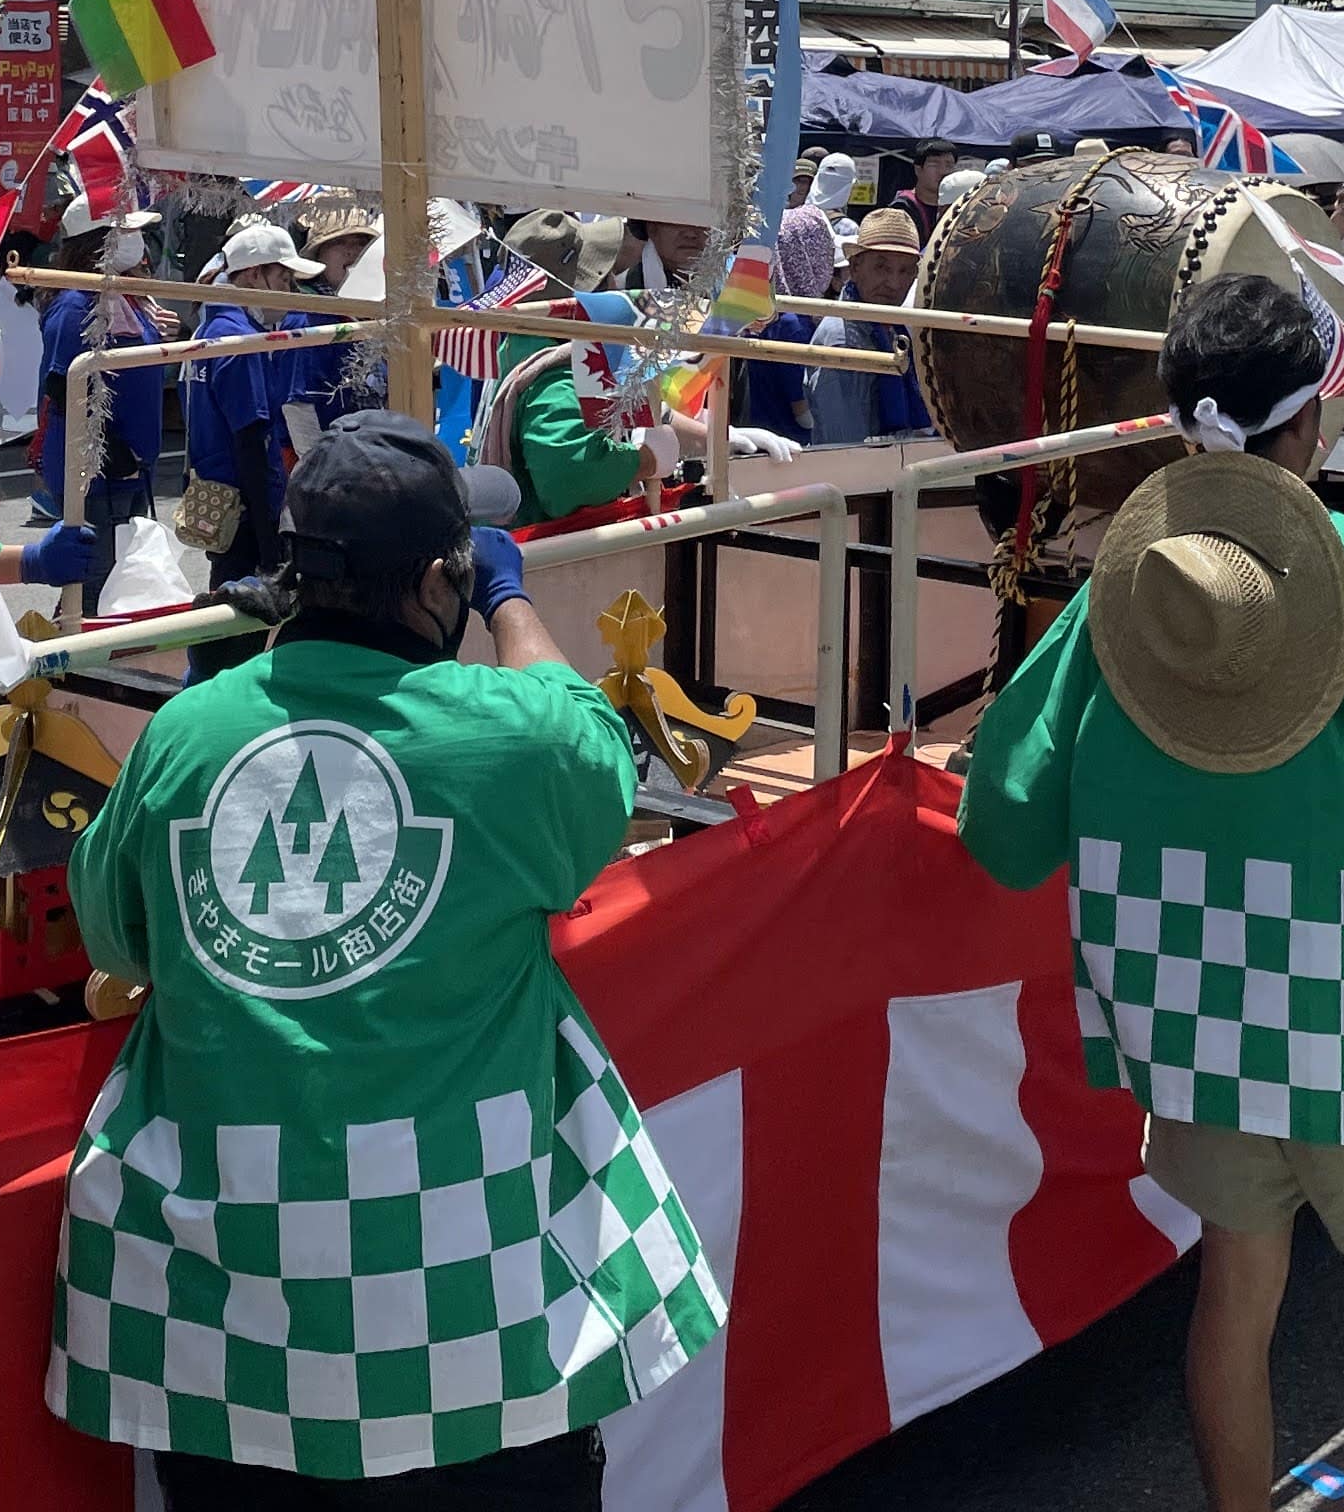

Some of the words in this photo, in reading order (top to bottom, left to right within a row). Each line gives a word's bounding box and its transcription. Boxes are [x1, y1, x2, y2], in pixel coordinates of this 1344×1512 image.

[7, 17, 42, 31] 当店で
[9, 31, 42, 46] 使える
[0, 60, 55, 81] PayPay
[187, 866, 426, 978] きやまモール商店街
